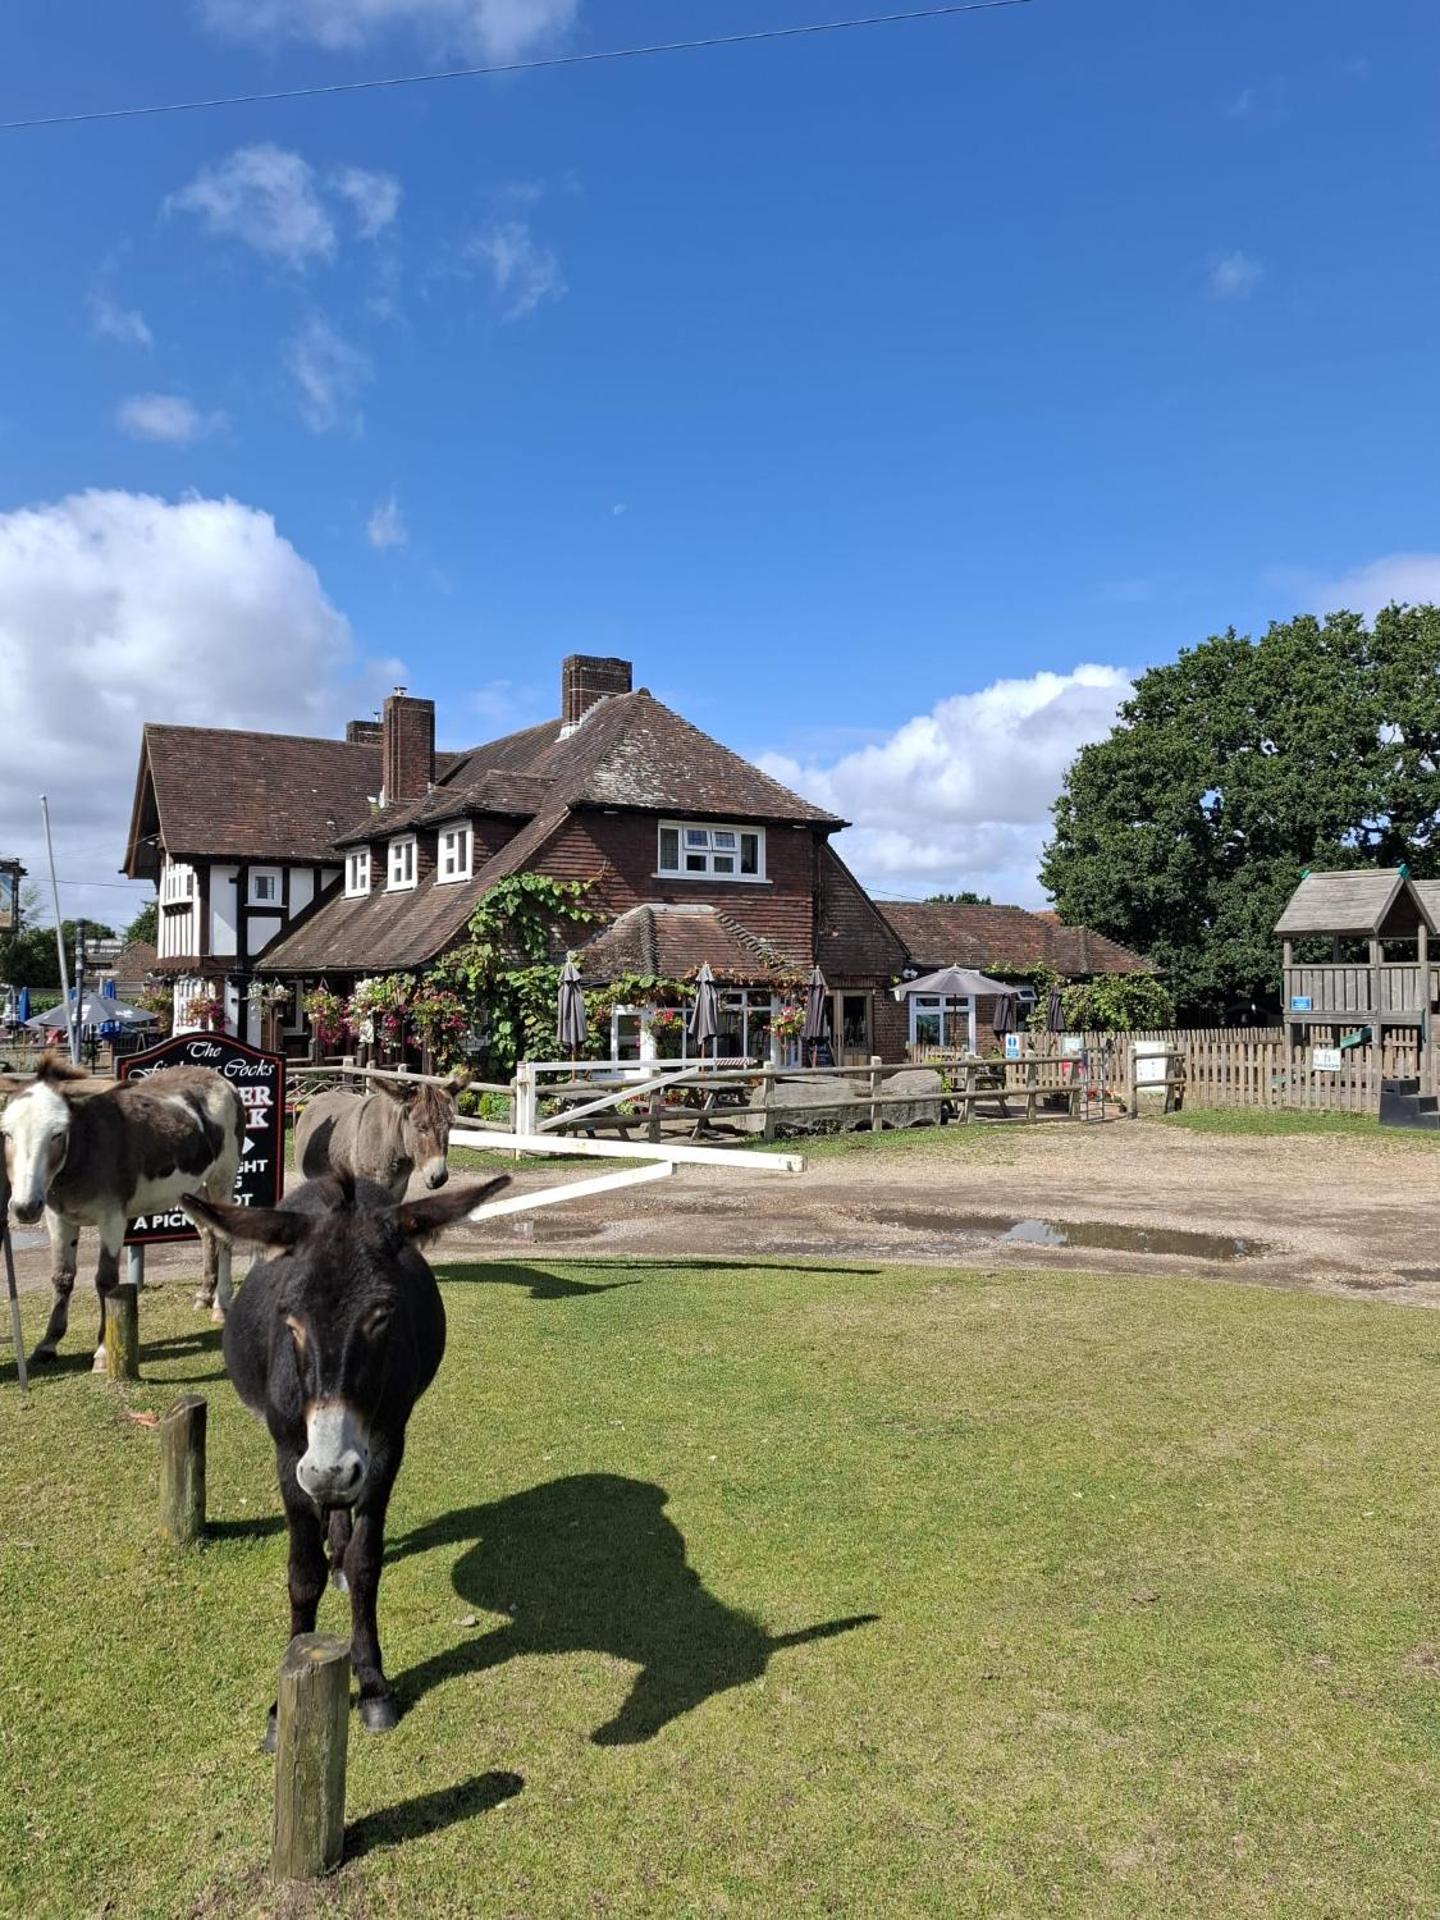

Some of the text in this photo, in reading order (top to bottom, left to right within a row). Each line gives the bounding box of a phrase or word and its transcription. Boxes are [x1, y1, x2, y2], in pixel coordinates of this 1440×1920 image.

[187, 1041, 222, 1058] The
[224, 1058, 275, 1077] Cocks
[133, 1213, 195, 1230] A PICN
